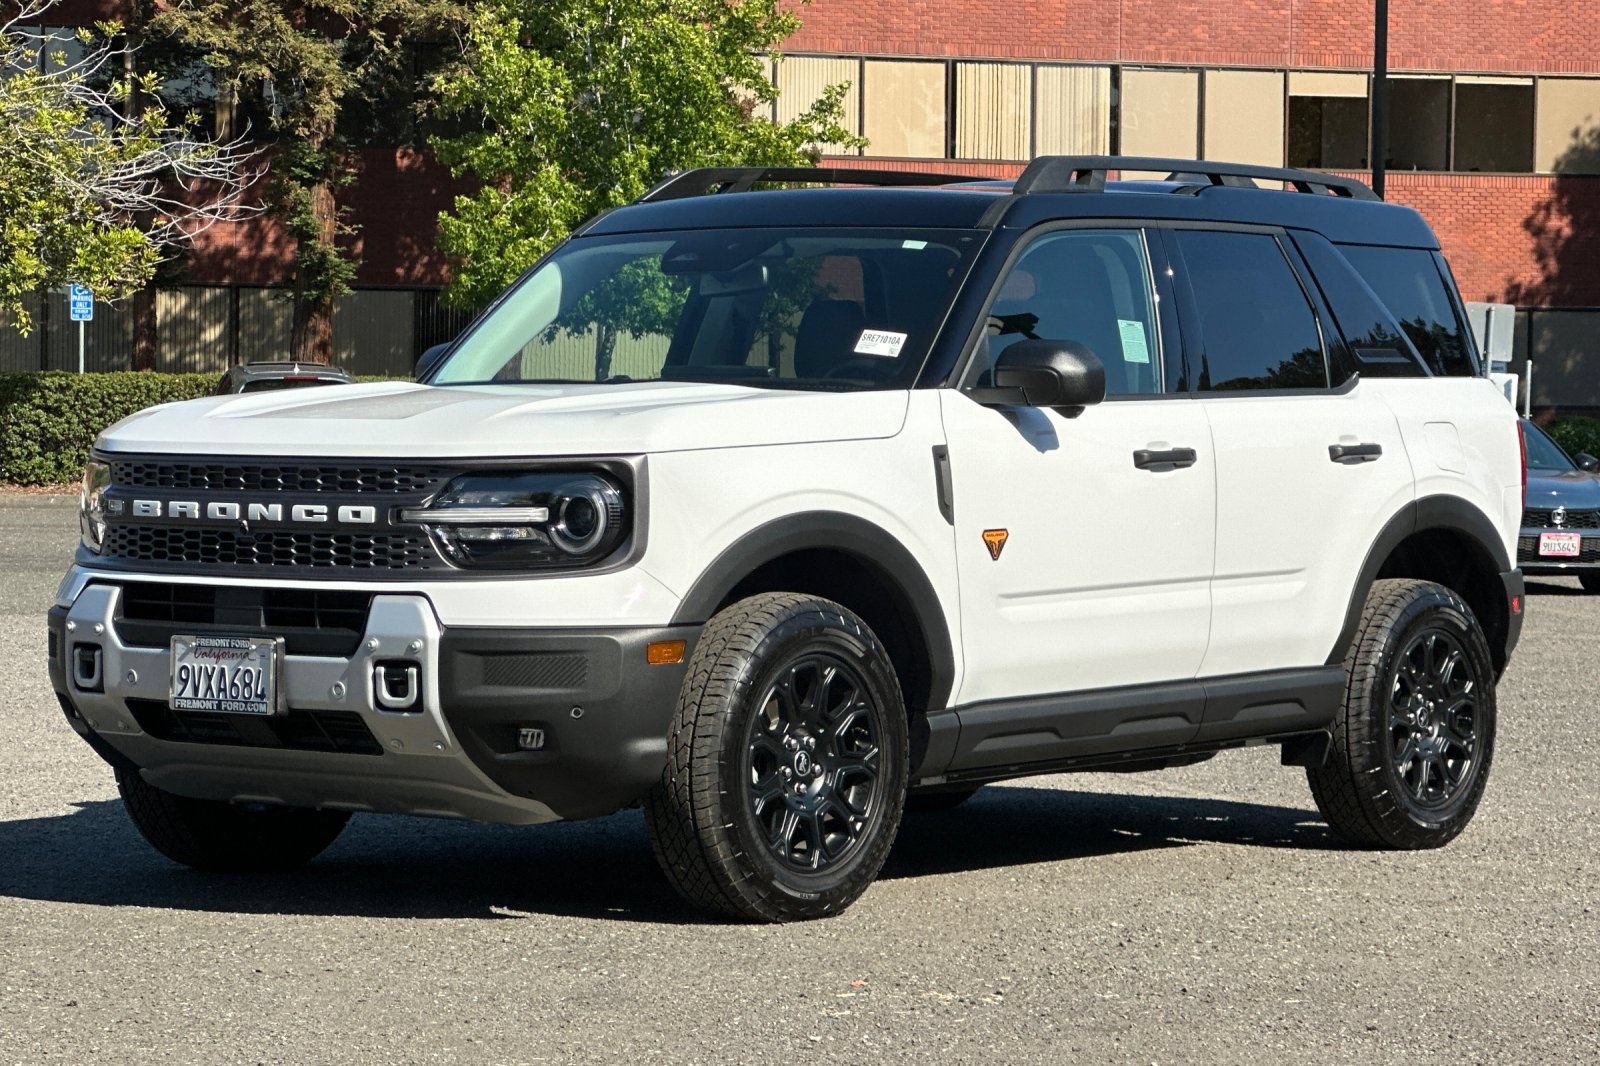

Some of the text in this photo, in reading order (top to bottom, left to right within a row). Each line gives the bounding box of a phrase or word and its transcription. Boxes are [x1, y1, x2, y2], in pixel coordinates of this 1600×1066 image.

[861, 333, 901, 345] SRE71010A
[132, 499, 376, 524] BRONCO
[196, 637, 251, 649] FREMONT FORD
[193, 647, 256, 664] California
[177, 664, 267, 701] 9VXA684
[175, 698, 267, 713] FREMONT FORD.COM
